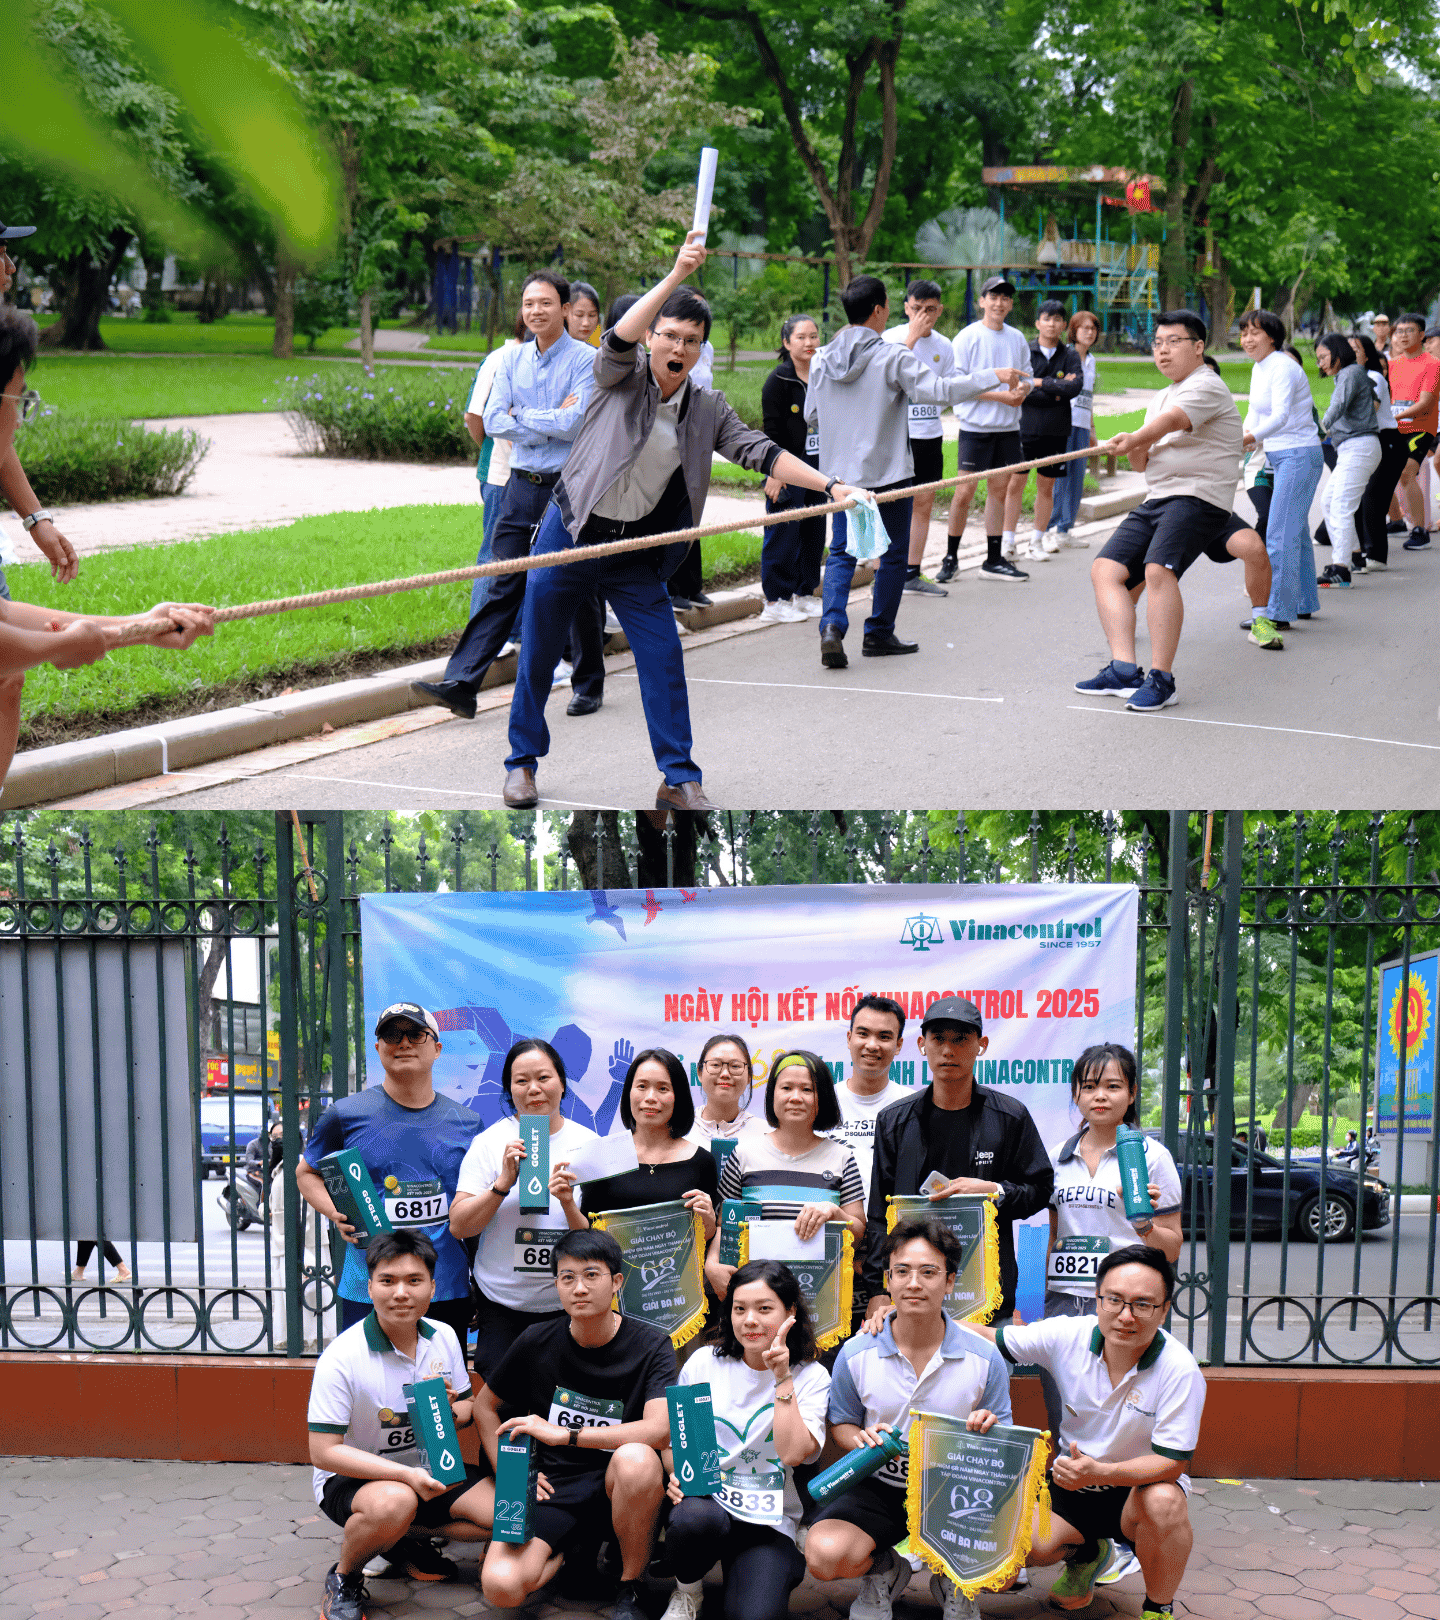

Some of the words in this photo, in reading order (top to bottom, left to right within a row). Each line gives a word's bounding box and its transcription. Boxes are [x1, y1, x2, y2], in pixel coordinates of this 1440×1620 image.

[912, 405, 938, 417] 6808
[949, 917, 1102, 940] Vinacontrol
[1039, 941, 1073, 949] SINCE
[1076, 940, 1101, 948] 1957
[664, 986, 723, 1022] NGÀY
[731, 986, 769, 1028] HỘI
[777, 985, 818, 1022] KẾT
[1036, 988, 1100, 1019] 2025
[531, 1127, 539, 1167] GOGLET
[974, 1151, 994, 1160] Jeep
[362, 1190, 382, 1228] GOGLET
[395, 1198, 442, 1219] 6817
[1057, 1186, 1116, 1209] REPUTE
[630, 1236, 645, 1245] GIẢI
[645, 1232, 665, 1242] CHẠY
[665, 1230, 676, 1239] BỘ
[640, 1256, 676, 1284] 68
[1055, 1256, 1098, 1274] 6821
[642, 1299, 659, 1311] GIẢI
[661, 1298, 672, 1308] BA
[954, 1292, 975, 1300] NAM
[428, 1395, 445, 1440] GOGLET
[676, 1402, 688, 1449] GOGLET
[701, 1449, 720, 1474] 22
[947, 1452, 965, 1462] GIẢI
[966, 1455, 990, 1467] CHẠY
[990, 1459, 1005, 1469] BỘ
[716, 1485, 776, 1512] 6833
[950, 1484, 994, 1510] 68
[495, 1499, 525, 1523] 22
[940, 1528, 957, 1544] GIẢI
[958, 1535, 971, 1549] BA
[973, 1539, 998, 1552] NAM
